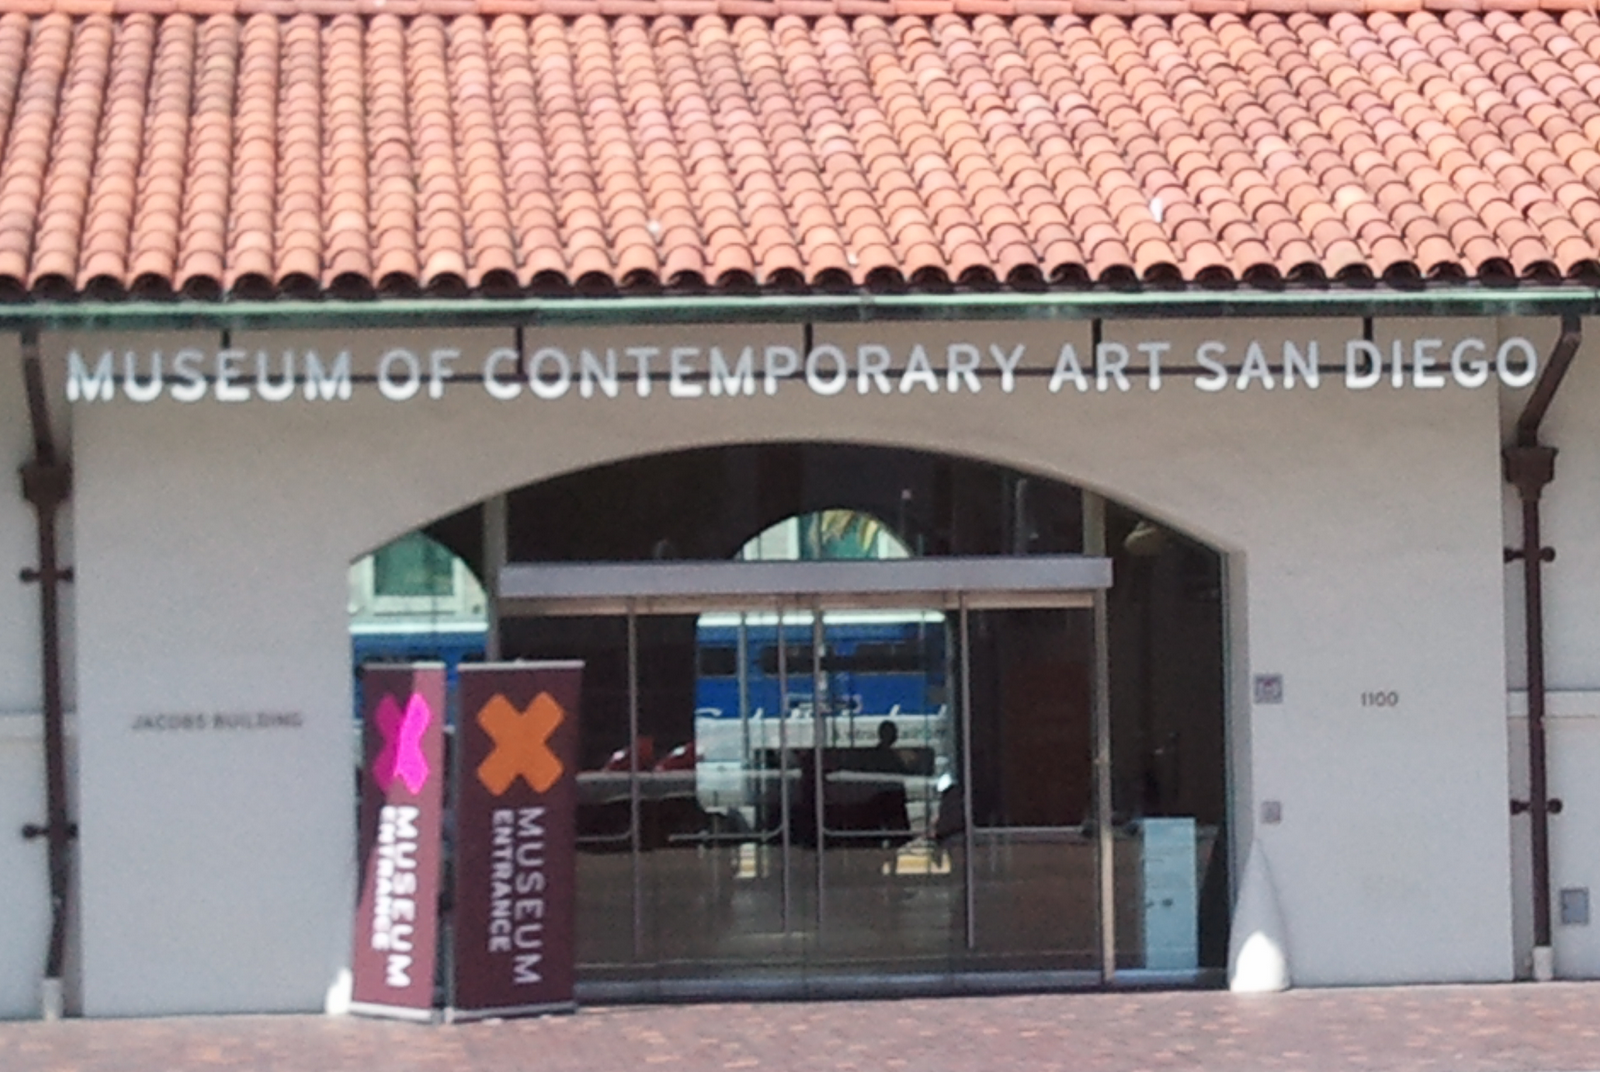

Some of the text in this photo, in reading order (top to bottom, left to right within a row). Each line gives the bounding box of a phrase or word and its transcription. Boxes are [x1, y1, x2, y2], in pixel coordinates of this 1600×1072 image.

[66, 336, 1538, 401] MUSEUM OF CONTEMPORARY ART SAN DIEGO
[1361, 691, 1399, 707] 1100
[385, 805, 420, 988] MUSEUM
[488, 809, 514, 953] ENTRANCE
[512, 806, 547, 985] MUSEUM
